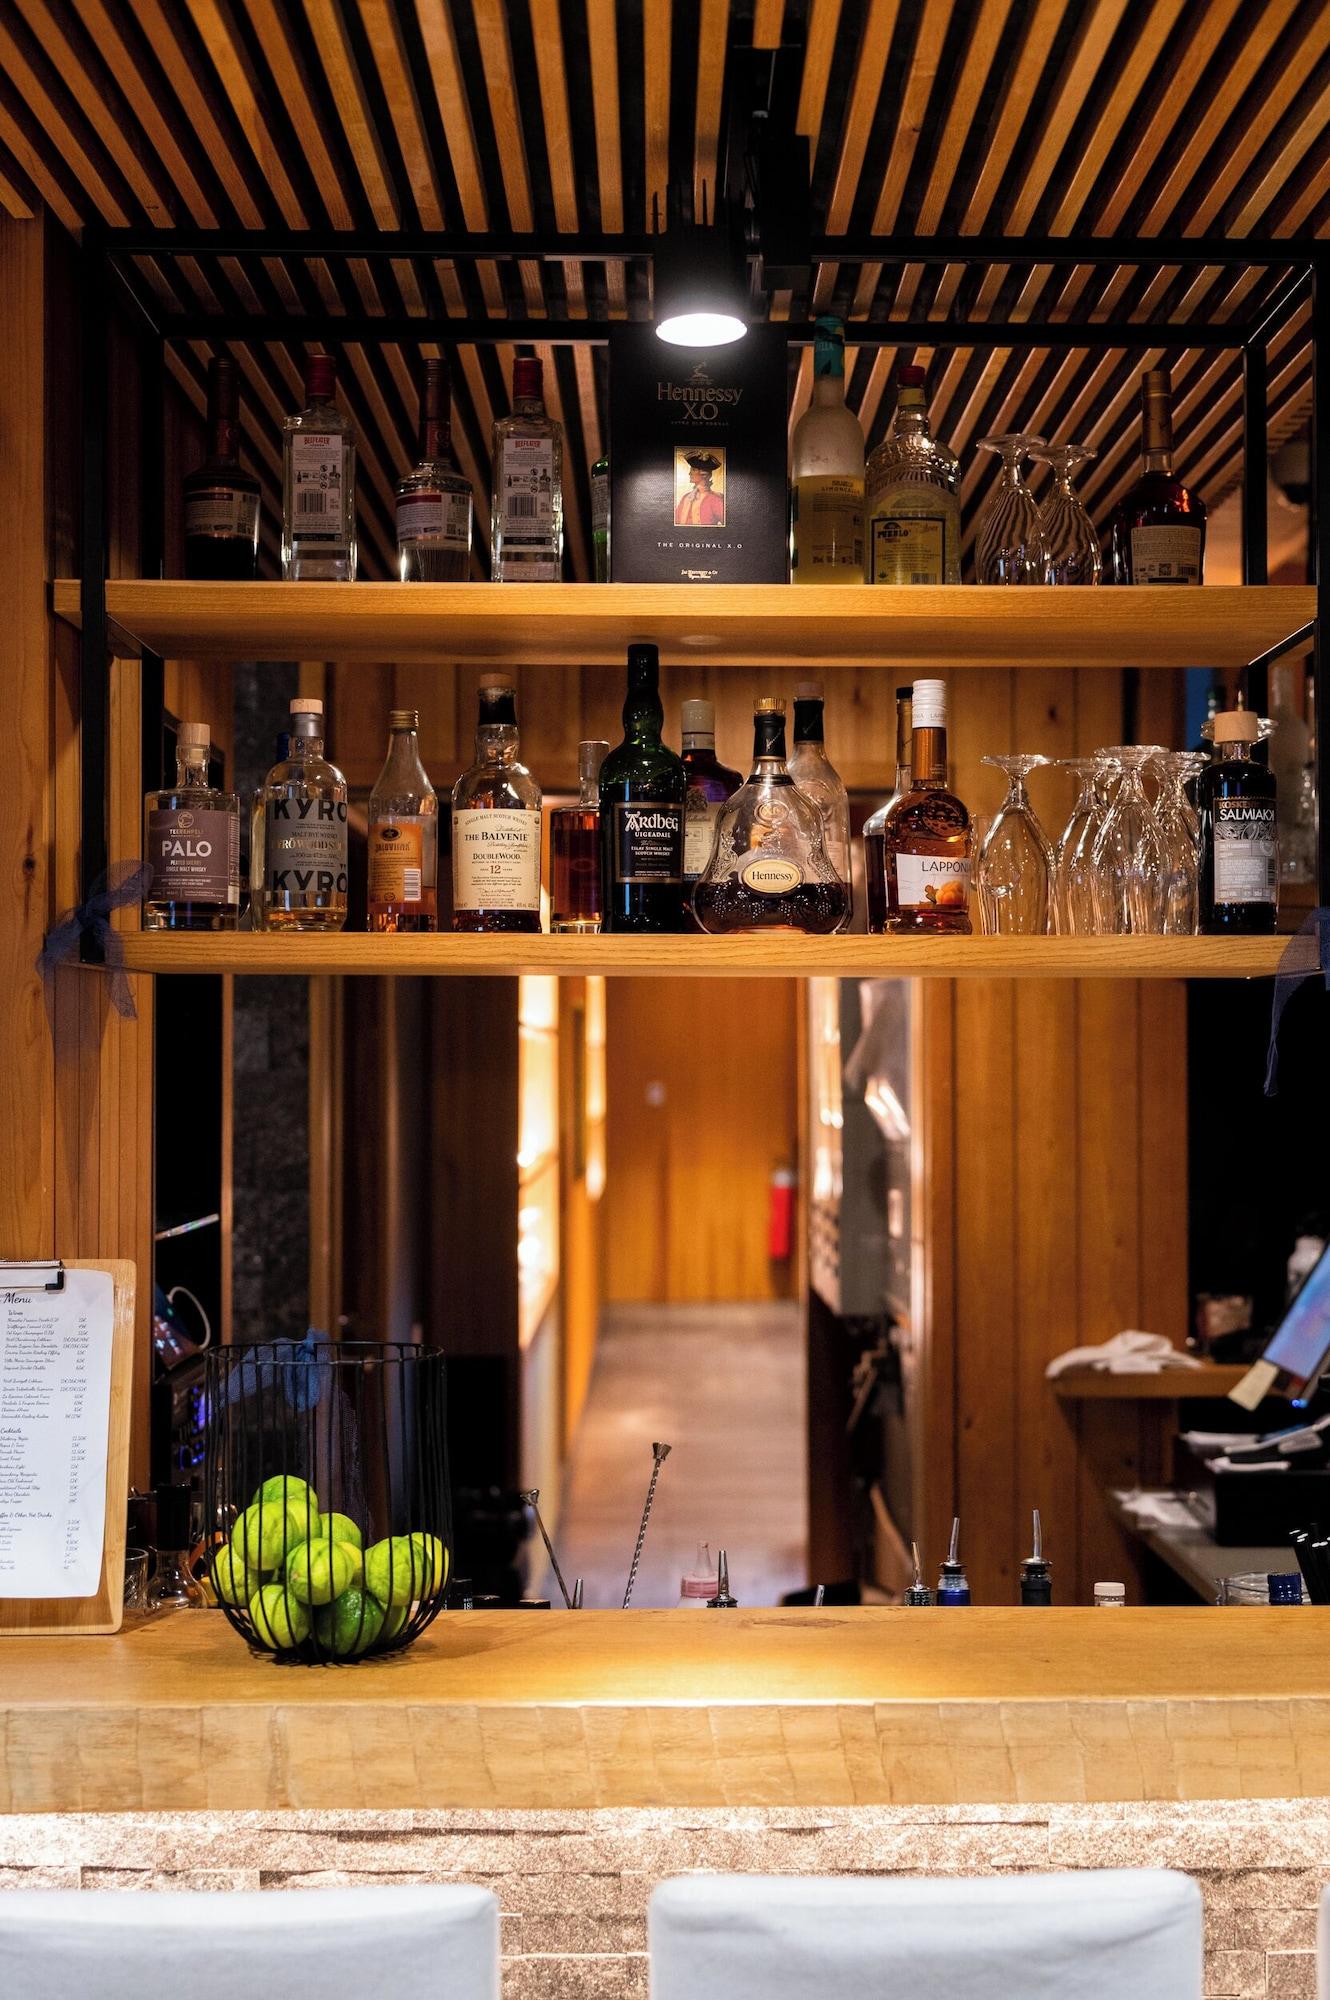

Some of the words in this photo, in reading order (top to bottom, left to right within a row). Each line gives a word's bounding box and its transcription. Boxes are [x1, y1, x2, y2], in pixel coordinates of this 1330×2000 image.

[657, 382, 743, 405] Hennessy
[304, 437, 330, 445] BEEFEATER
[515, 440, 541, 448] BEEFEATER
[465, 816, 479, 826] SINGLE
[624, 811, 679, 832] Ardbeg
[481, 831, 528, 841] BALVENIE
[161, 840, 212, 857] PALO
[490, 865, 501, 873] 12
[752, 871, 794, 882] Hennessy
[3, 1292, 33, 1304] Menu
